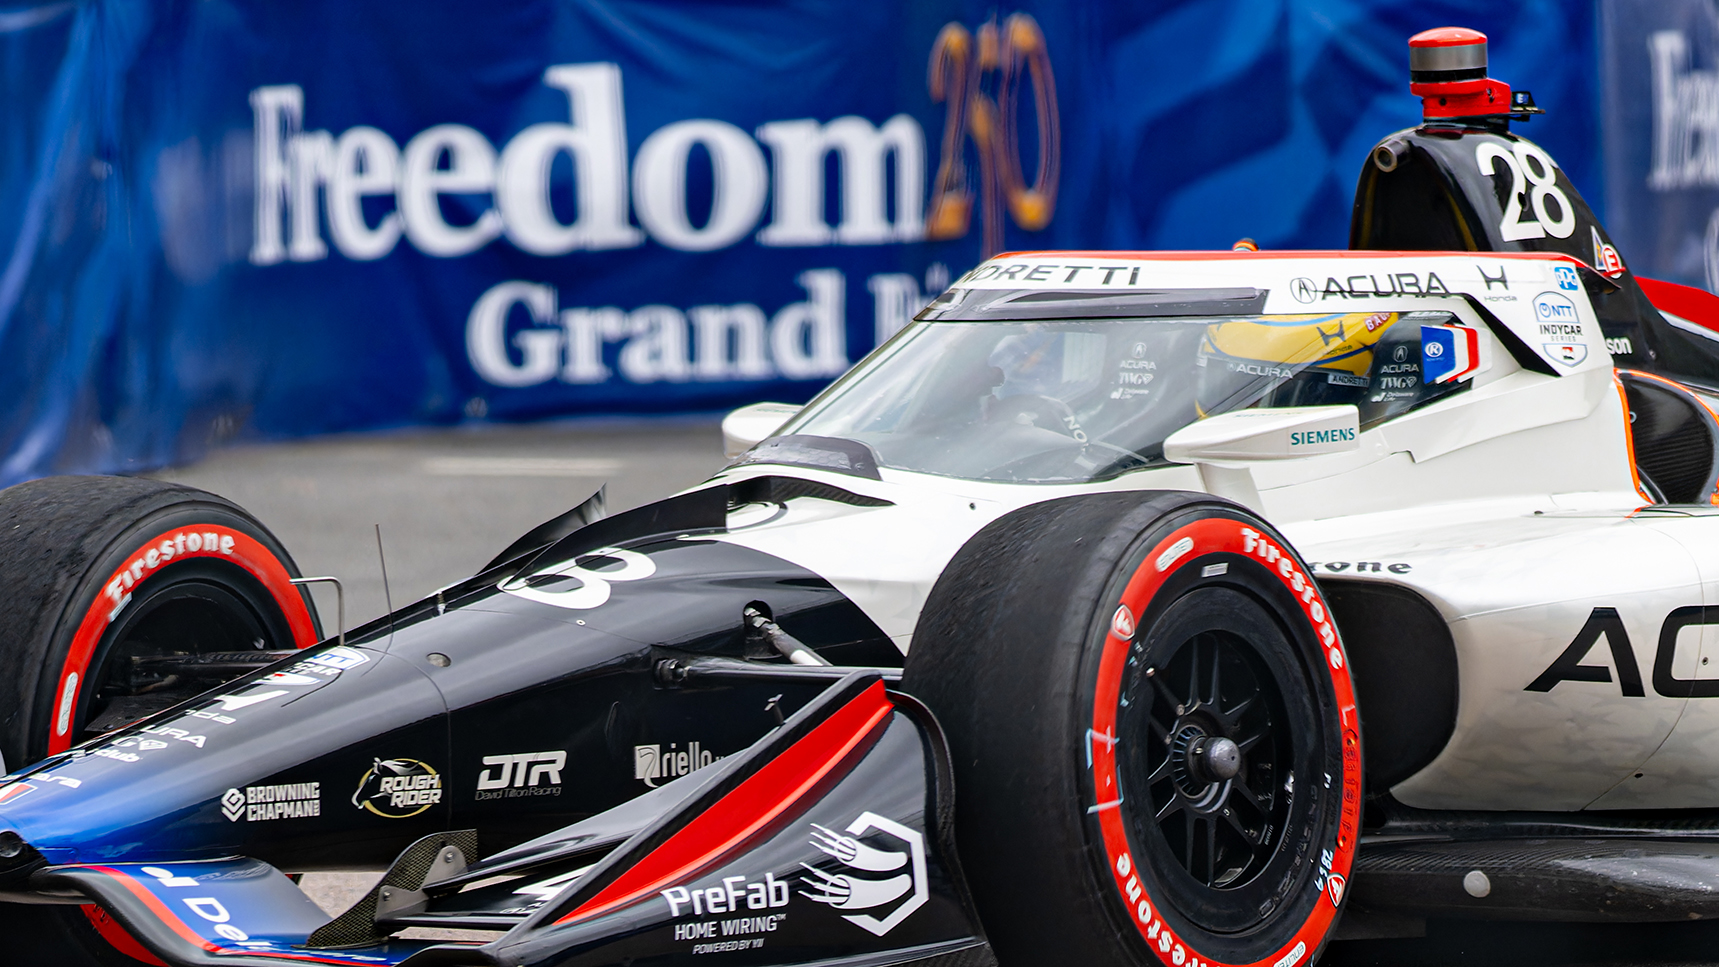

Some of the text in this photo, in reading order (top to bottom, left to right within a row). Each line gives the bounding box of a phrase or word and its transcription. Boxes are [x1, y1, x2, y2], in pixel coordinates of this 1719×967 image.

[250, 62, 928, 265] Freedom
[1476, 142, 1576, 242] 28
[1321, 271, 1451, 300] ACURA
[1555, 267, 1578, 290] PPG
[1551, 304, 1572, 317] NTT
[466, 269, 852, 388] Grand
[1540, 324, 1583, 336] INDYCAR
[1550, 335, 1576, 343] SERIES
[1605, 337, 1633, 355] son
[1120, 360, 1157, 370] ACURA
[1236, 363, 1293, 379] ACURA
[1380, 364, 1420, 374] ACURA
[1290, 428, 1355, 446] SIEMENS
[106, 532, 236, 603] Firestone
[1241, 528, 1343, 669] Firestone
[1523, 605, 1719, 698] AC
[140, 724, 207, 749] URA
[477, 750, 567, 790] DTR
[246, 781, 320, 804] BROWNING
[379, 774, 440, 793] ROUGH
[475, 789, 502, 801] David
[529, 786, 562, 797] Racing
[389, 788, 442, 808] RIDER
[246, 800, 314, 822] CHAPMAN
[660, 872, 790, 917] PreFab
[674, 920, 717, 941] HOME
[692, 941, 738, 955] POWERED
[738, 939, 752, 951] BY
